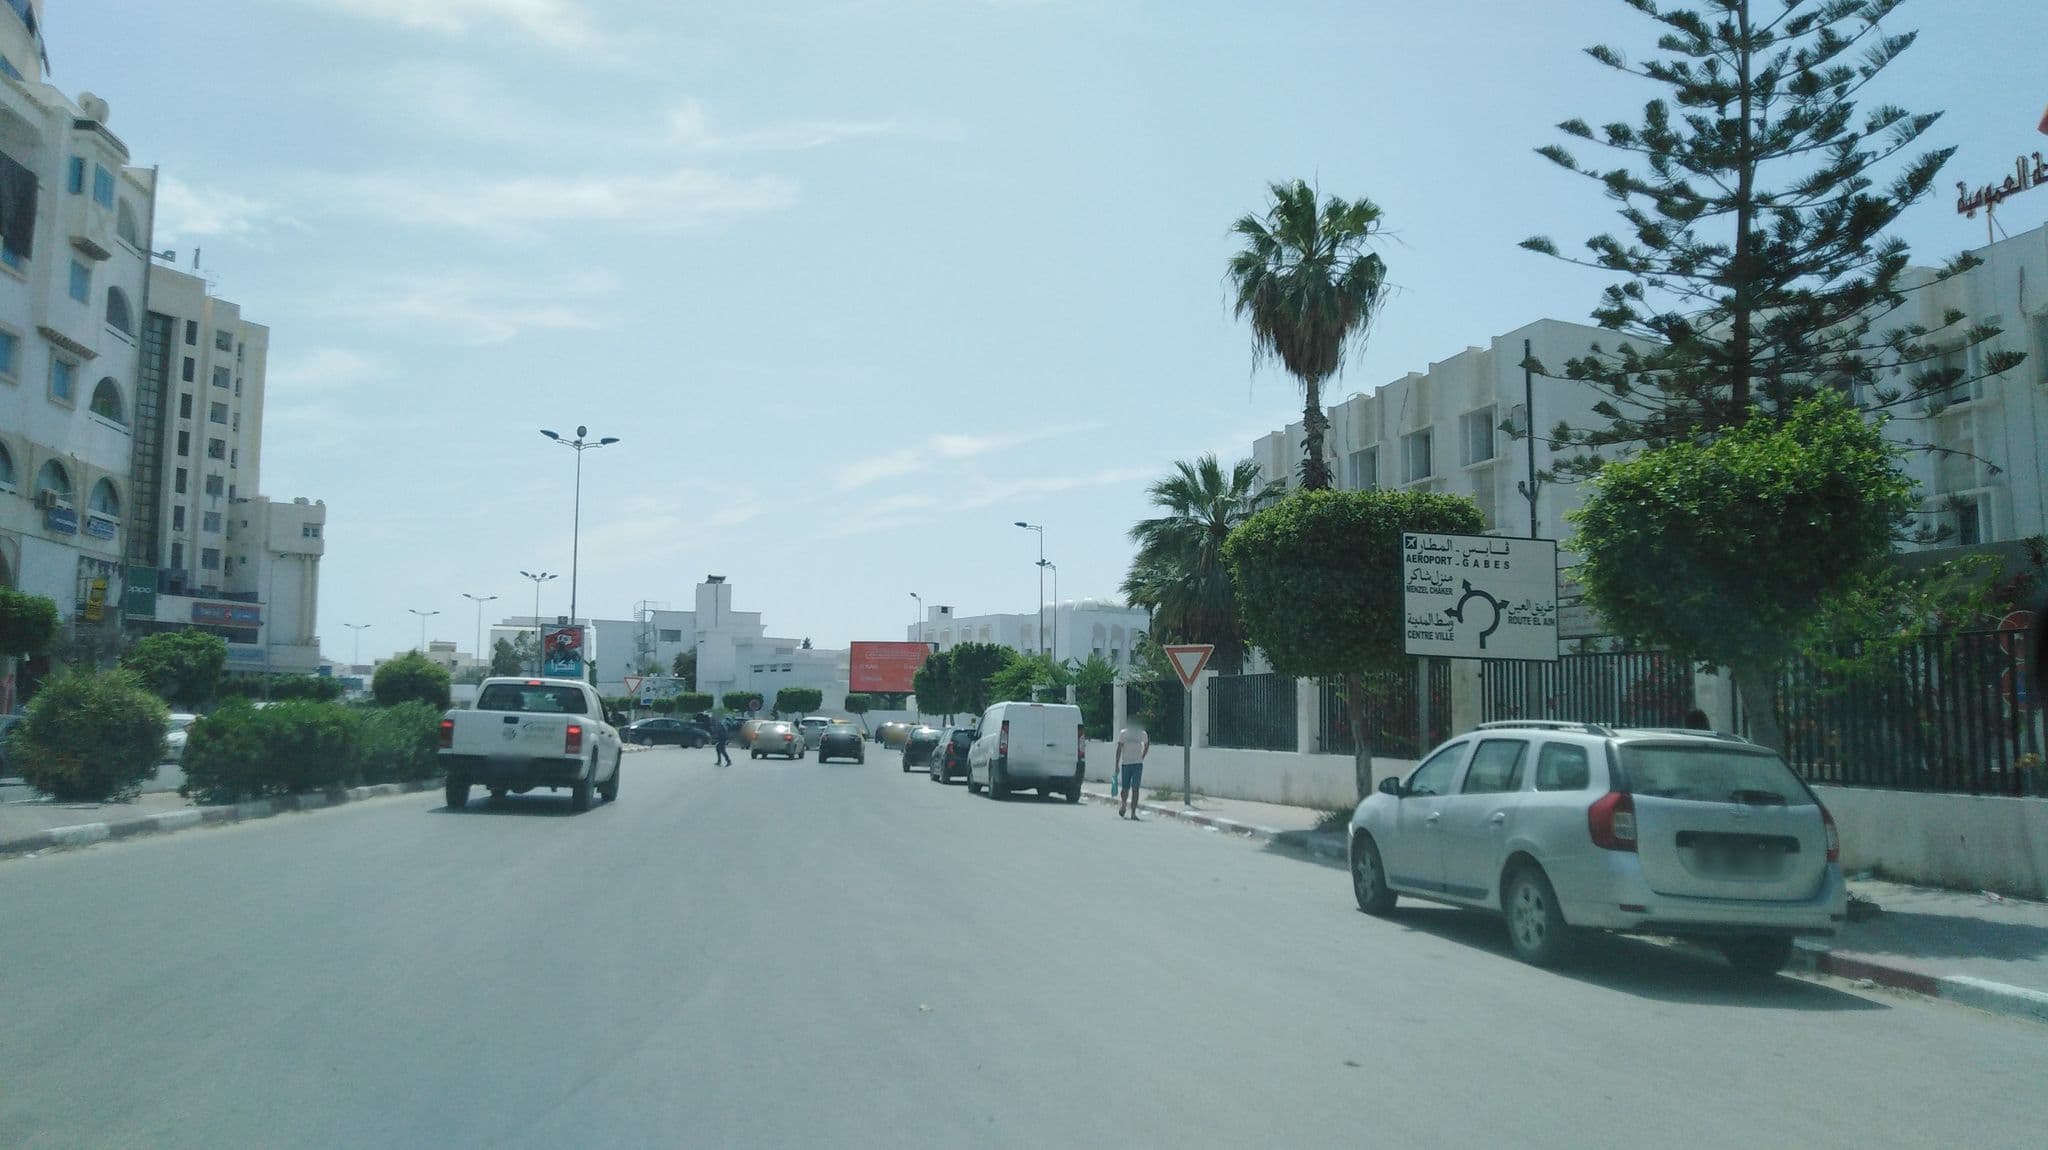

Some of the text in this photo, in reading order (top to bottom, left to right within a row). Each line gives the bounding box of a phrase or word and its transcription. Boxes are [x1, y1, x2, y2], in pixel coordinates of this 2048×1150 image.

[1956, 155, 2028, 218] العمومية
[1417, 537, 1453, 555] المطار
[1405, 554, 1453, 565] AEROPORT
[1407, 568, 1453, 586] منزل شاكر
[1406, 585, 1453, 595] MENZEL CHAKER
[1508, 599, 1531, 615] العين
[1407, 612, 1454, 631] وسط المدينة
[1508, 616, 1555, 626] ROUTE EL AIN
[1407, 630, 1454, 641] CENTRE VILLE
